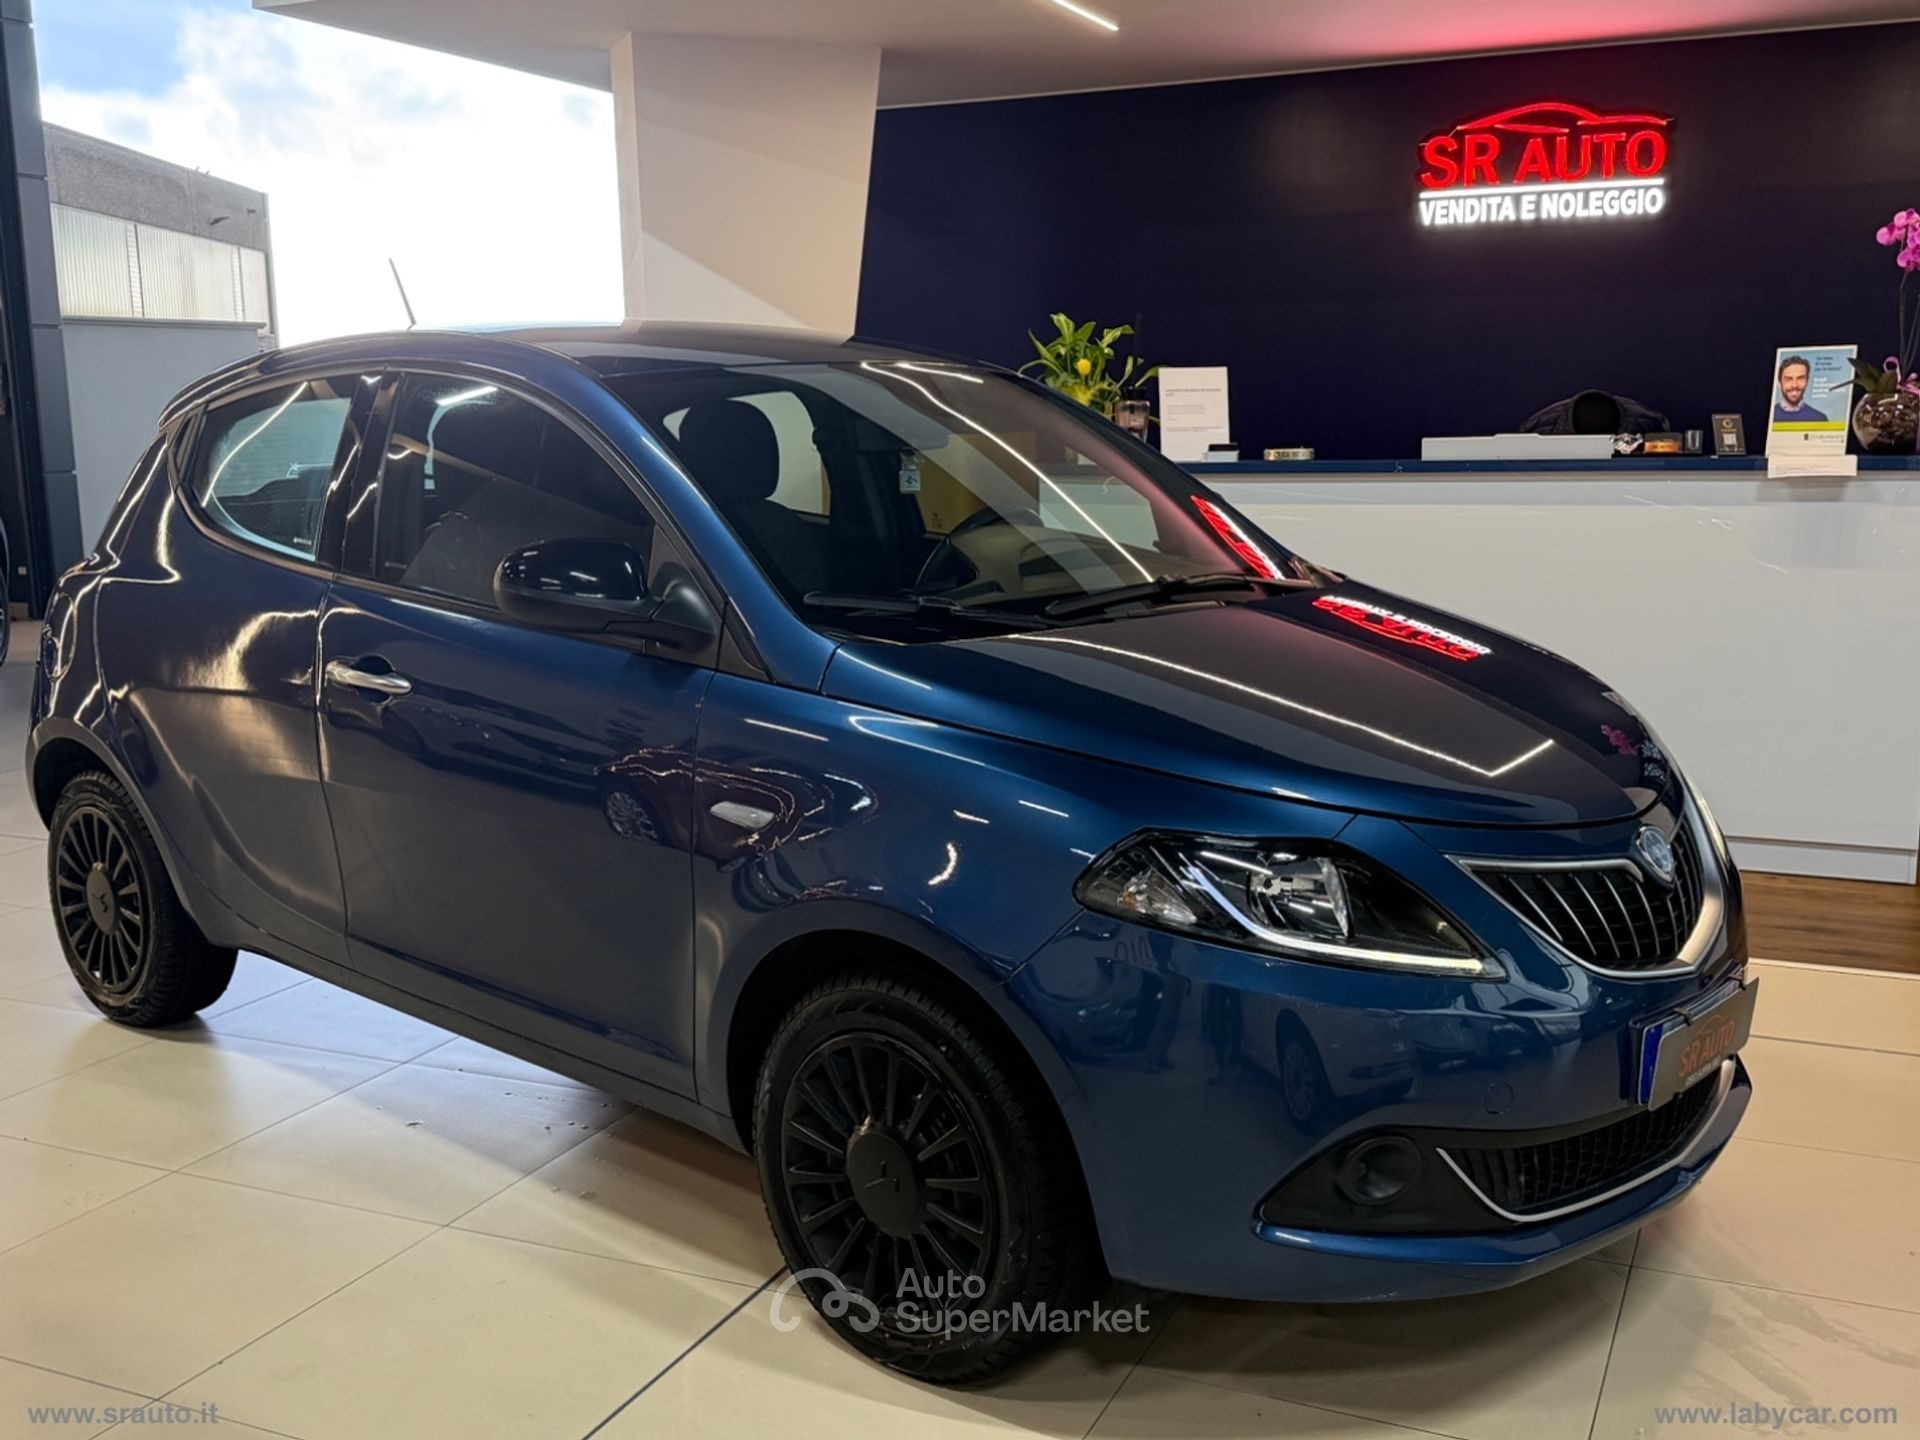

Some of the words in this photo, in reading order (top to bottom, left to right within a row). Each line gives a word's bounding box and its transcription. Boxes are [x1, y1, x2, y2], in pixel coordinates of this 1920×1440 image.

[1421, 134, 1500, 189] SR
[1513, 130, 1667, 184] AUTO
[1419, 196, 1516, 226] VENDITA
[1520, 195, 1537, 220] E
[1541, 188, 1665, 219] NOLEGGIO
[1679, 1039, 1701, 1077] SR
[1698, 1020, 1735, 1065] AUTO
